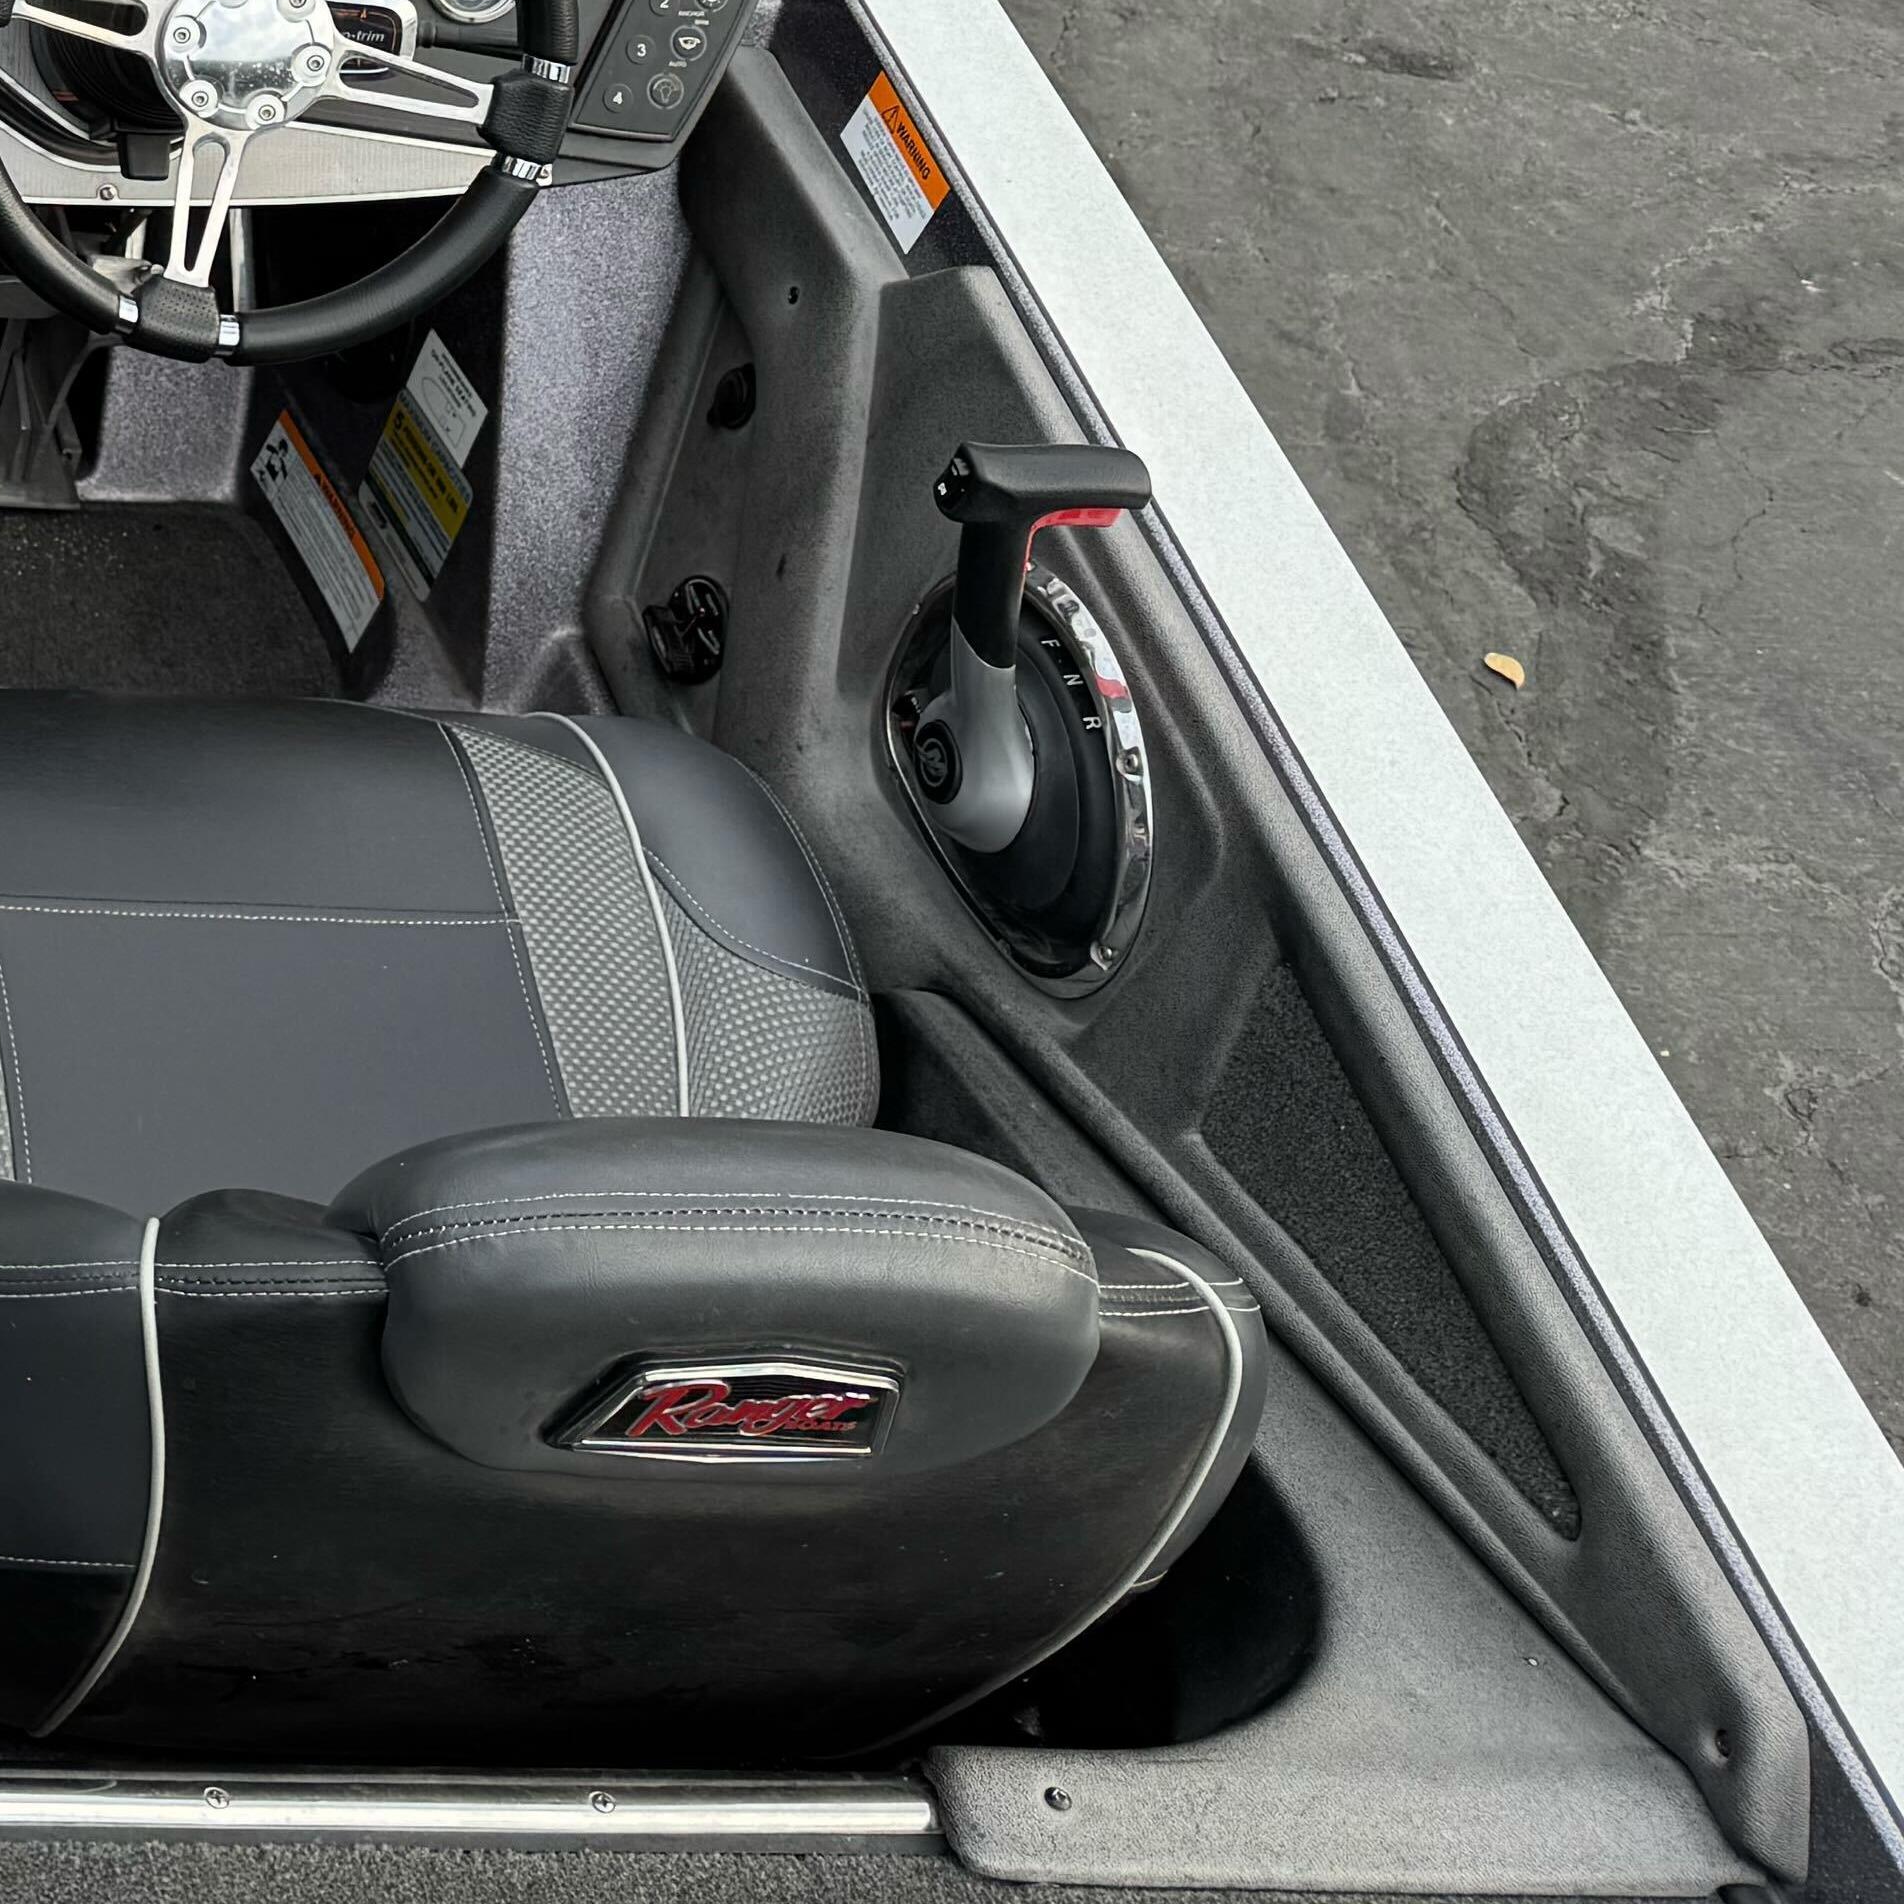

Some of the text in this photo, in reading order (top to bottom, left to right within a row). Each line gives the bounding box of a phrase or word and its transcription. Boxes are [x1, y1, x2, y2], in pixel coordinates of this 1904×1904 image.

[637, 43, 647, 57] 3
[613, 91, 623, 105] 4
[896, 121, 932, 181] WARNING
[1041, 639, 1061, 647] F
[1063, 674, 1084, 686] N
[1082, 716, 1103, 730] R
[625, 1379, 876, 1437] Ranger
